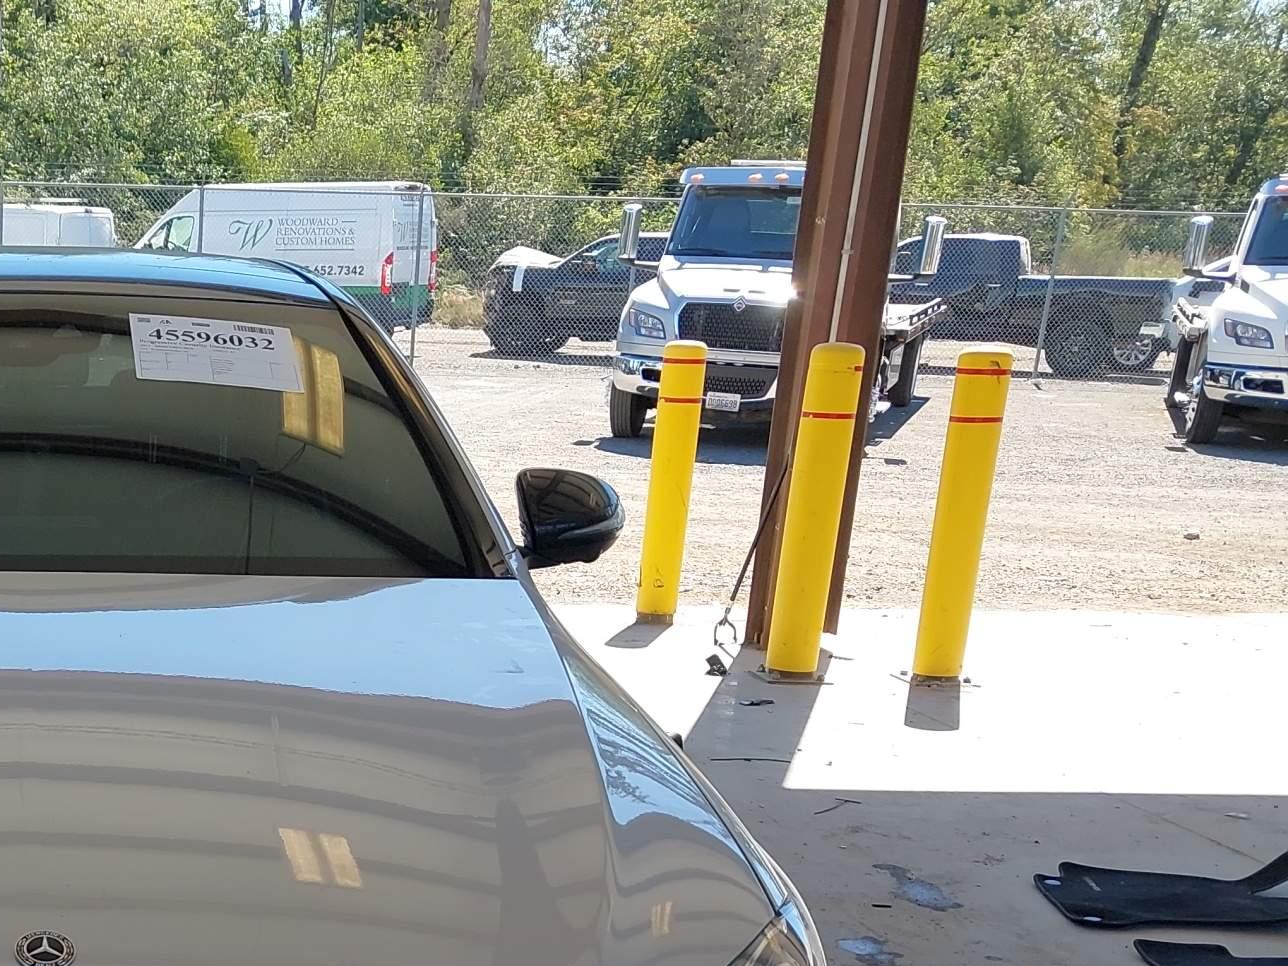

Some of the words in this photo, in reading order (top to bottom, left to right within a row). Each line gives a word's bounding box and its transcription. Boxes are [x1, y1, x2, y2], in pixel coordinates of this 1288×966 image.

[278, 217, 338, 226] WOODWARD
[276, 227, 346, 236] RENOVATIONS
[275, 237, 317, 246] CUSTOM
[320, 237, 355, 246] HOMES
[148, 328, 275, 350] 45596032
